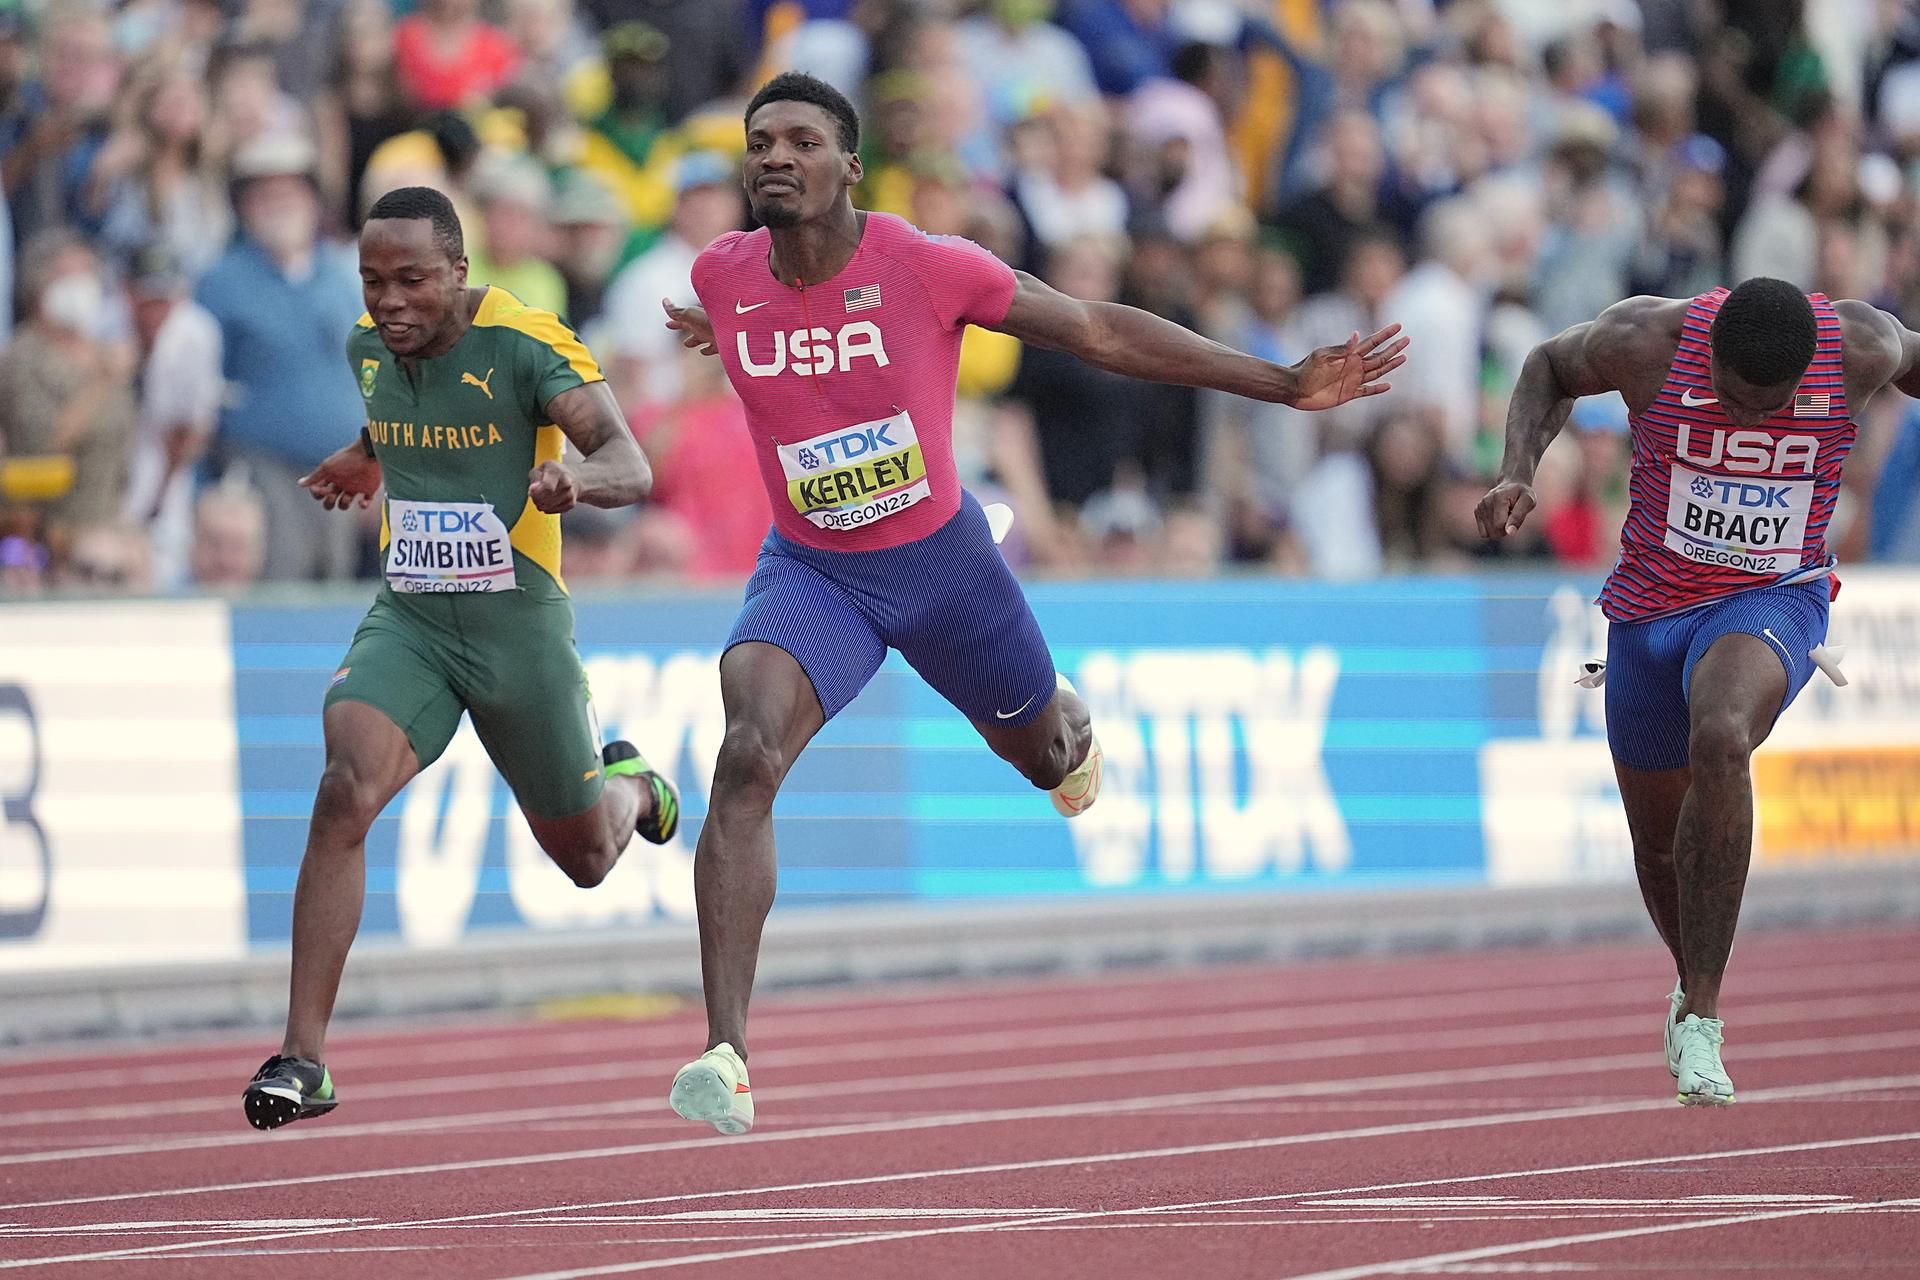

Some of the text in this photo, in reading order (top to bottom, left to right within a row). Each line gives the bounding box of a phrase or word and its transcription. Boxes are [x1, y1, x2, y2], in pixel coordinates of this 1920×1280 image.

[736, 320, 891, 378] USA
[367, 418, 504, 450] OUTH AFRICA
[814, 422, 898, 465] TDK
[1676, 423, 1821, 475] USA
[799, 451, 911, 508] KERLEY
[1714, 480, 1793, 509] TDK
[417, 510, 488, 534] TDK
[823, 492, 911, 529] OREGON22
[1683, 501, 1791, 546] BRACY
[394, 537, 505, 569] SIMBINE
[1683, 542, 1777, 572] OREGON22
[404, 578, 494, 593] OREGON22
